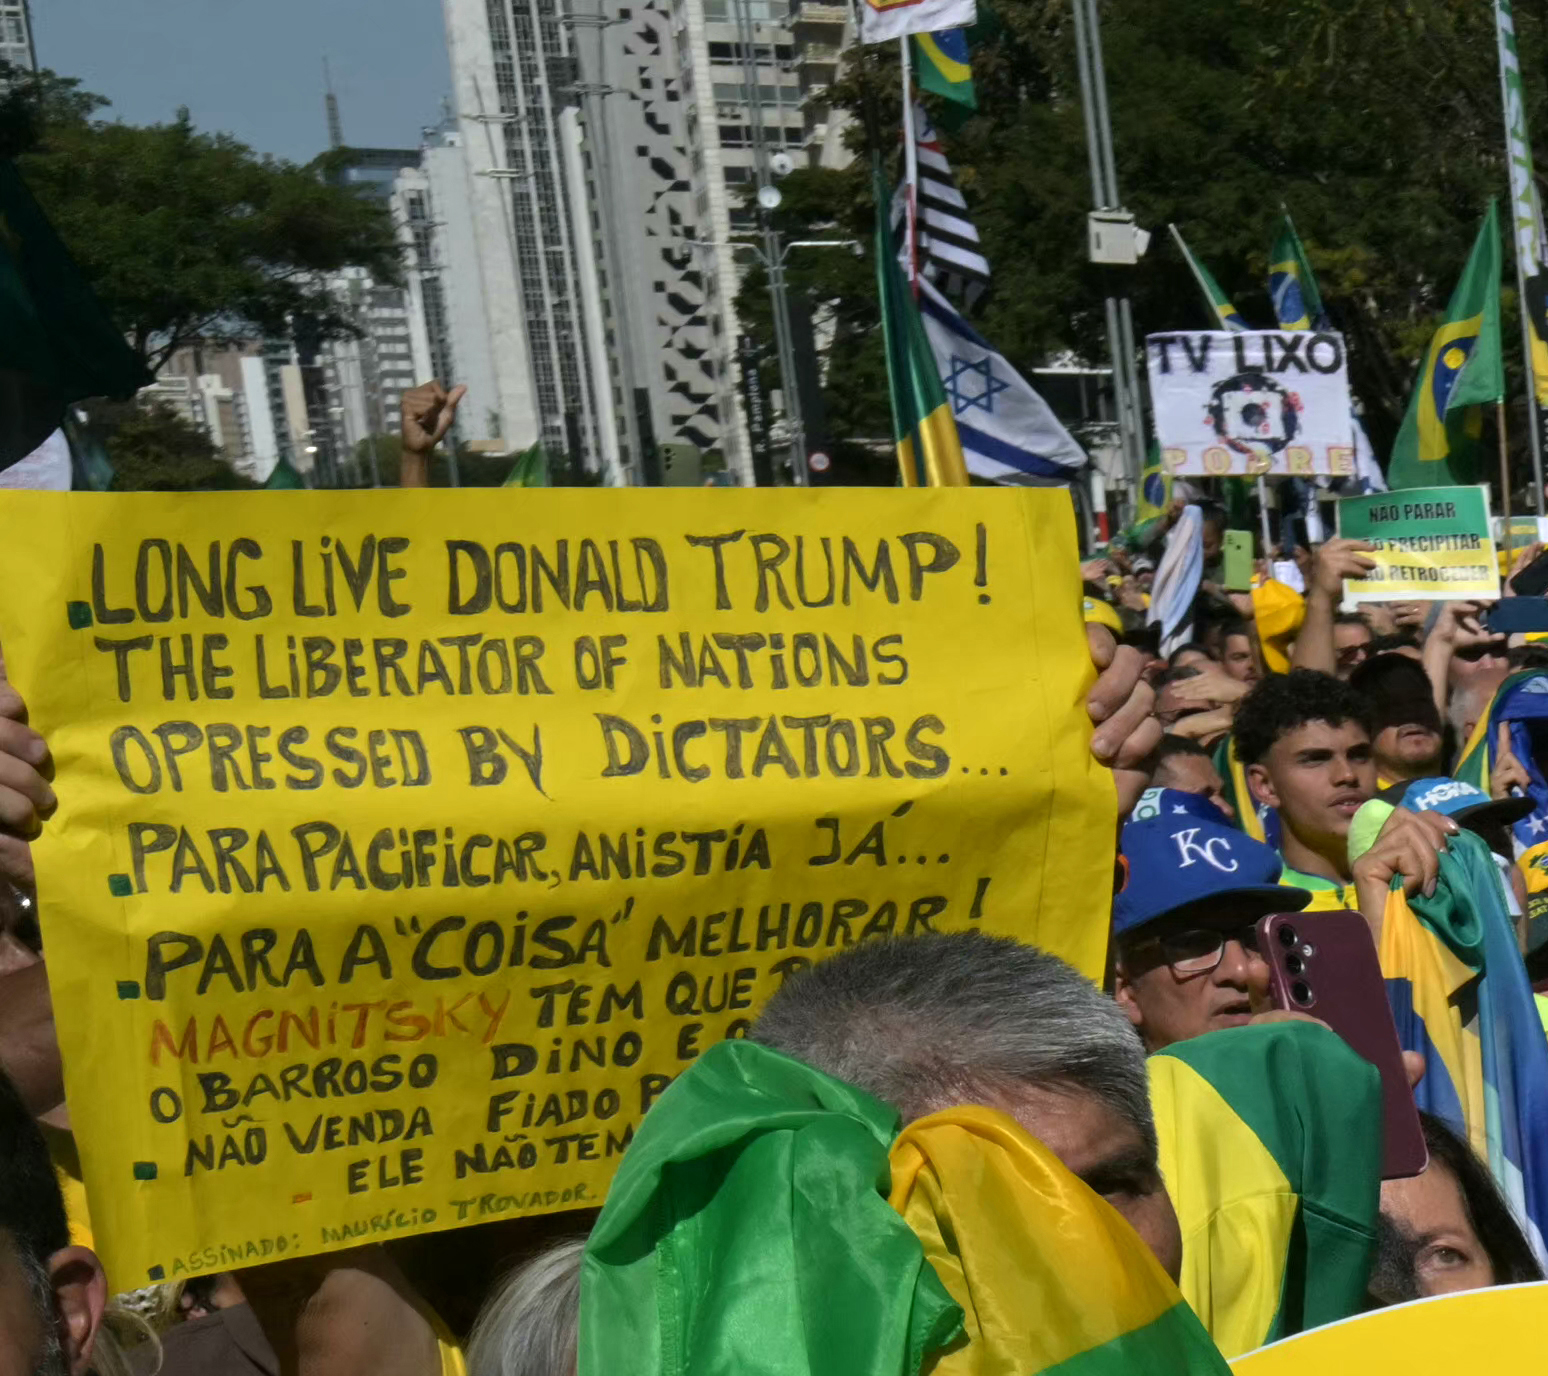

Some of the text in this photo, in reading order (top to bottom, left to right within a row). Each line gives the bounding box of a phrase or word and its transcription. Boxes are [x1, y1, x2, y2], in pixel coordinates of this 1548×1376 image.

[1150, 332, 1343, 375] TV LIXO
[1404, 501, 1457, 521] PARAR
[92, 538, 273, 625] LONG
[445, 537, 670, 616] DONALD
[93, 632, 235, 702] THE
[573, 632, 629, 692] OF
[110, 720, 432, 795] OPRESSED
[456, 723, 557, 801] BY
[126, 820, 292, 895] PARA
[1169, 826, 1239, 873] KC
[145, 924, 326, 1002] PARA
[338, 924, 393, 985] A
[530, 976, 645, 1030] TEM
[664, 967, 758, 1016] QUE
[149, 1086, 183, 1124] O
[196, 1052, 440, 1117] BARROSO
[183, 1113, 268, 1178] NÃO
[283, 1104, 434, 1157] VENDA
[346, 1146, 426, 1196] ELE
[454, 1132, 538, 1181] NÃO
